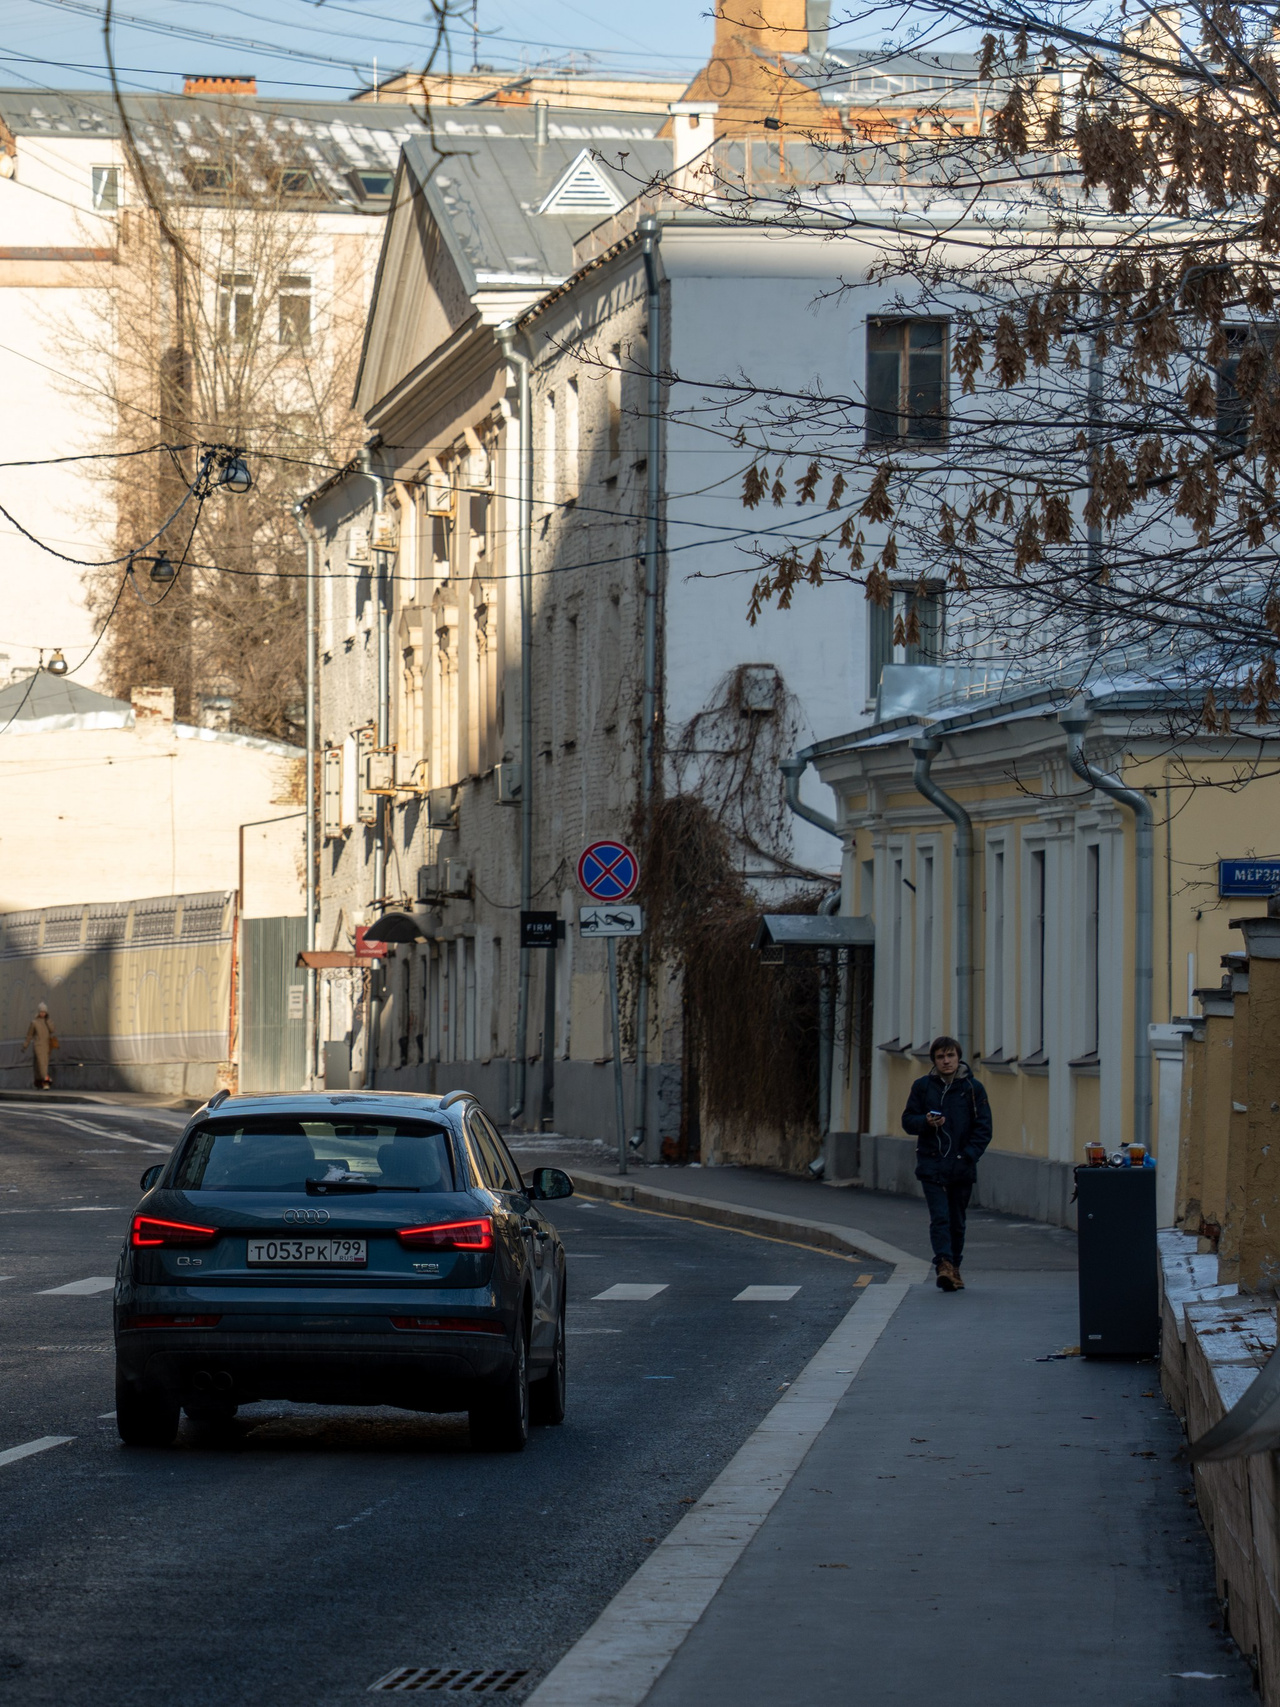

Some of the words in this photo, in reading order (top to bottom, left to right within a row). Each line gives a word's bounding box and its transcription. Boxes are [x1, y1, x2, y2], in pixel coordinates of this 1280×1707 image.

[526, 923, 552, 931] FIRM
[332, 1241, 362, 1255] 799
[177, 1256, 202, 1266] Q3
